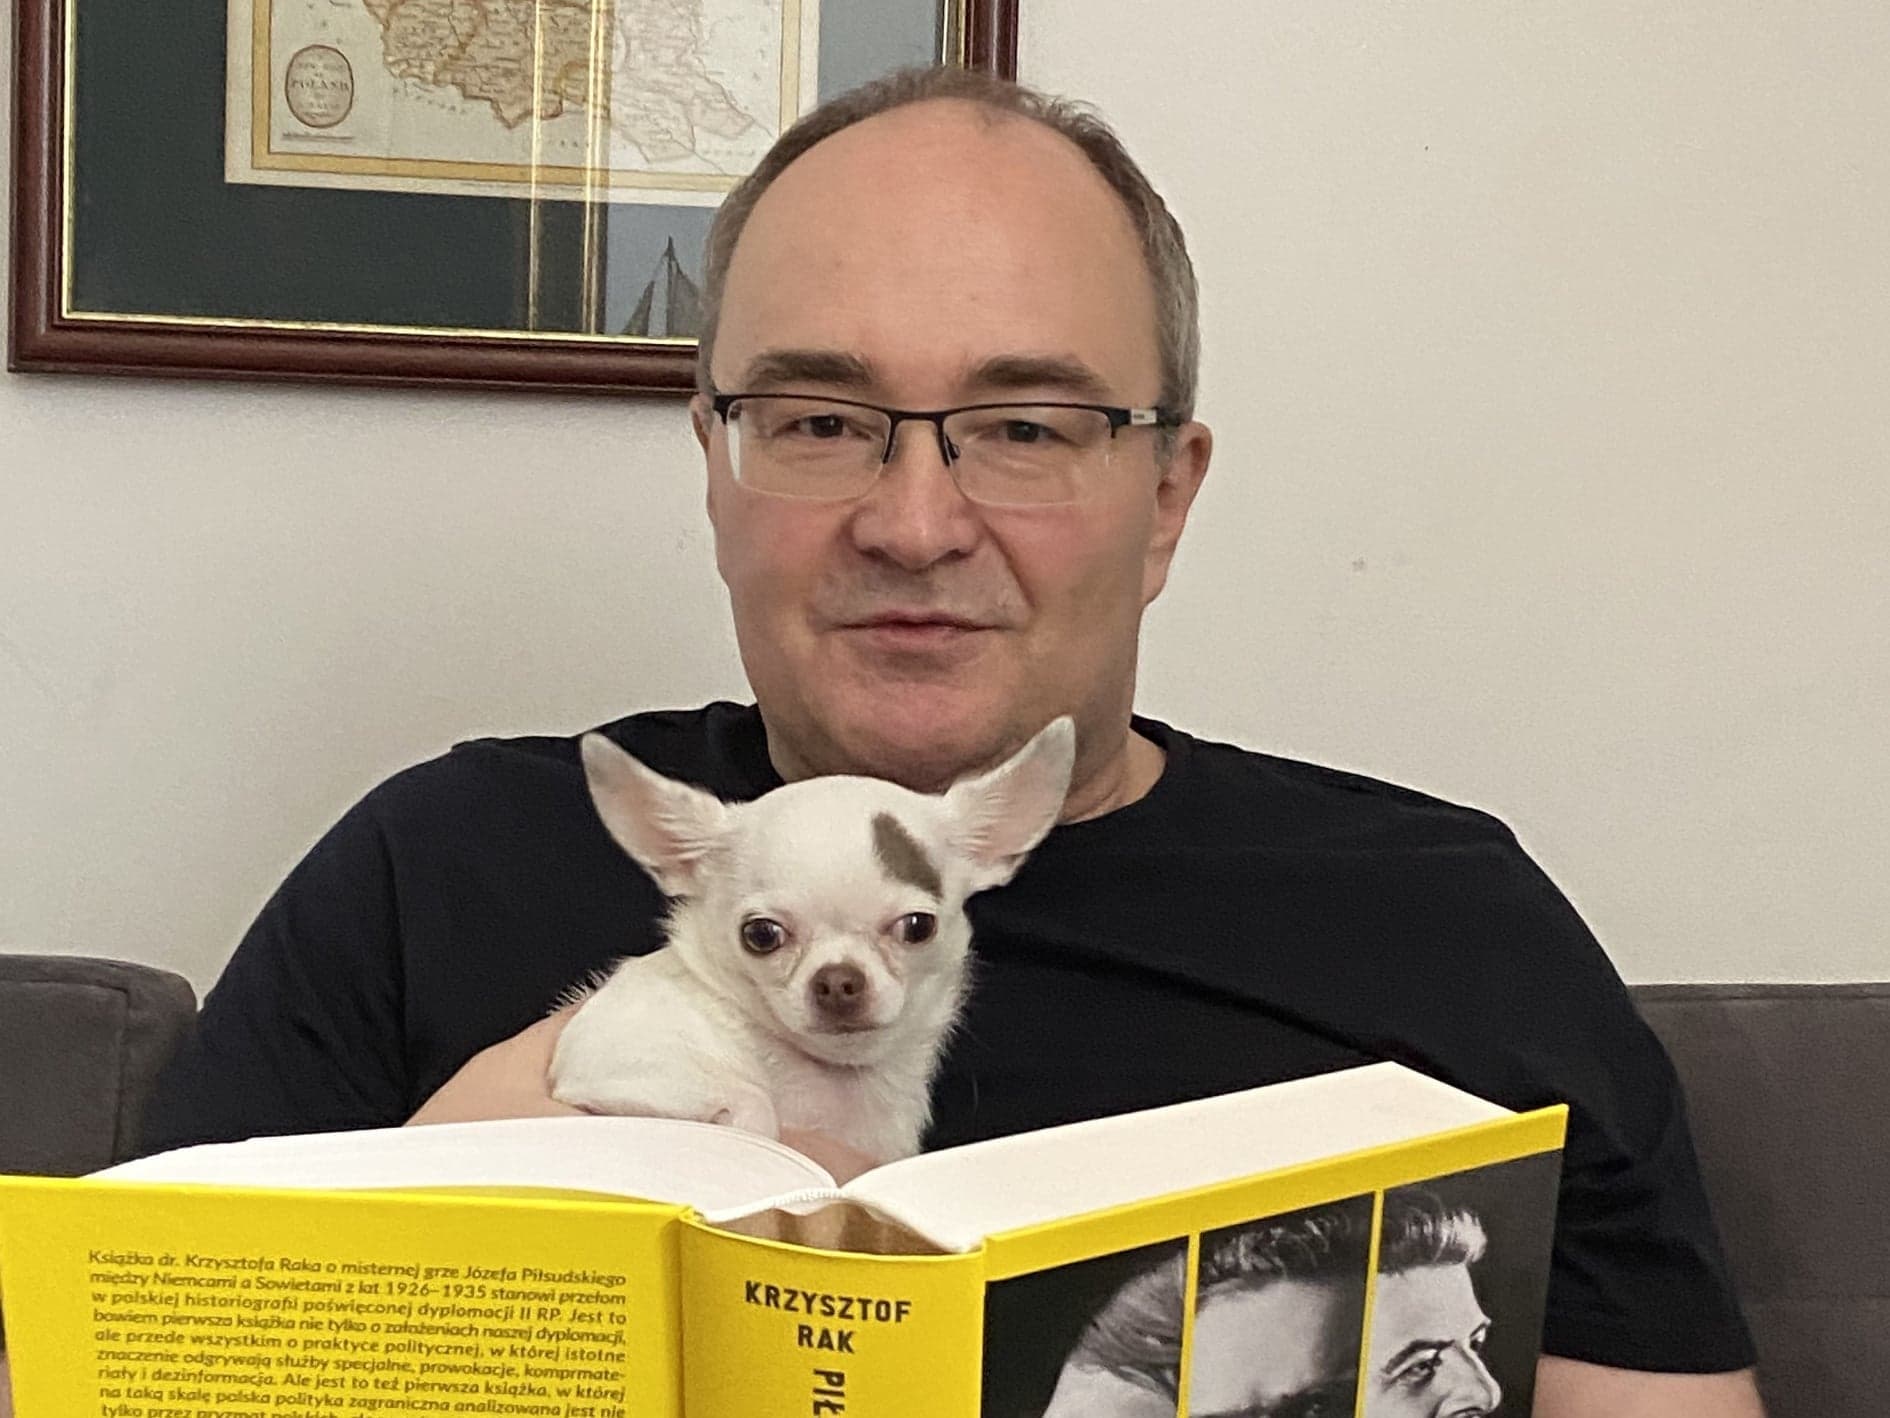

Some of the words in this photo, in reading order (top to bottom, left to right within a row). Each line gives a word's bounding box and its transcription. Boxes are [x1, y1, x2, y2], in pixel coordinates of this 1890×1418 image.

[89, 1250, 153, 1266] Książka
[158, 1253, 180, 1266] dr.
[185, 1254, 275, 1272] Krzysztofa
[280, 1257, 321, 1272] Raka
[326, 1262, 337, 1273] o
[341, 1261, 420, 1279] misternej
[424, 1266, 459, 1280] grze
[464, 1265, 517, 1281] Józefa
[522, 1268, 626, 1288] Piłsudskiego
[90, 1271, 149, 1287] między
[153, 1273, 236, 1288] Niemcami
[240, 1279, 251, 1289] a
[255, 1276, 342, 1292] Sowietami
[345, 1283, 354, 1294] z
[358, 1280, 379, 1294] lat
[491, 1287, 555, 1301] stanowi
[559, 1290, 627, 1305] przełom
[745, 1280, 912, 1323] KRZYSZTOF
[92, 1292, 107, 1302] w
[112, 1291, 180, 1308] polskiej
[304, 1299, 413, 1318] poświęconej
[418, 1302, 514, 1322] dyplomacji
[520, 1306, 531, 1320] II
[568, 1309, 602, 1324] Jest
[609, 1311, 627, 1325] to
[94, 1308, 158, 1323] bowiem
[162, 1311, 233, 1327] pierwsza
[237, 1314, 295, 1330] książka
[300, 1316, 323, 1330] nie
[328, 1318, 366, 1334] tylko
[370, 1323, 381, 1333] o
[384, 1320, 479, 1337] założeniach
[483, 1326, 532, 1342] naszej
[536, 1327, 627, 1346] dyplomacji,
[797, 1324, 855, 1354] RAK
[95, 1330, 121, 1342] ale
[126, 1331, 185, 1345] przede
[190, 1333, 282, 1348] wszystkim
[287, 1338, 298, 1348] o
[303, 1337, 379, 1354] praktyce
[384, 1339, 485, 1359] politycznej,
[490, 1347, 506, 1357] w
[509, 1344, 560, 1362] której
[565, 1348, 626, 1363] istotne
[97, 1349, 179, 1364] znaczenie
[183, 1350, 272, 1370] odgrywają
[276, 1354, 329, 1371] służby
[419, 1361, 520, 1379] prowokacje,
[98, 1366, 138, 1382] riały
[141, 1367, 147, 1380] i
[283, 1373, 311, 1386] Ale
[315, 1374, 346, 1389] jest
[352, 1376, 369, 1389] to
[374, 1377, 400, 1391] też
[404, 1377, 480, 1393] pierwsza
[484, 1381, 551, 1398] książka,
[556, 1387, 572, 1398] w
[576, 1384, 626, 1403] której
[100, 1386, 121, 1398] na
[126, 1386, 163, 1402] taką
[168, 1387, 210, 1403] skalę
[215, 1390, 271, 1404] polska
[274, 1392, 344, 1408] polityka
[349, 1397, 450, 1411] zagraniczna
[454, 1399, 561, 1417] analizowana
[564, 1403, 595, 1418] jest
[600, 1404, 626, 1418] nie
[102, 1403, 143, 1418] tylko
